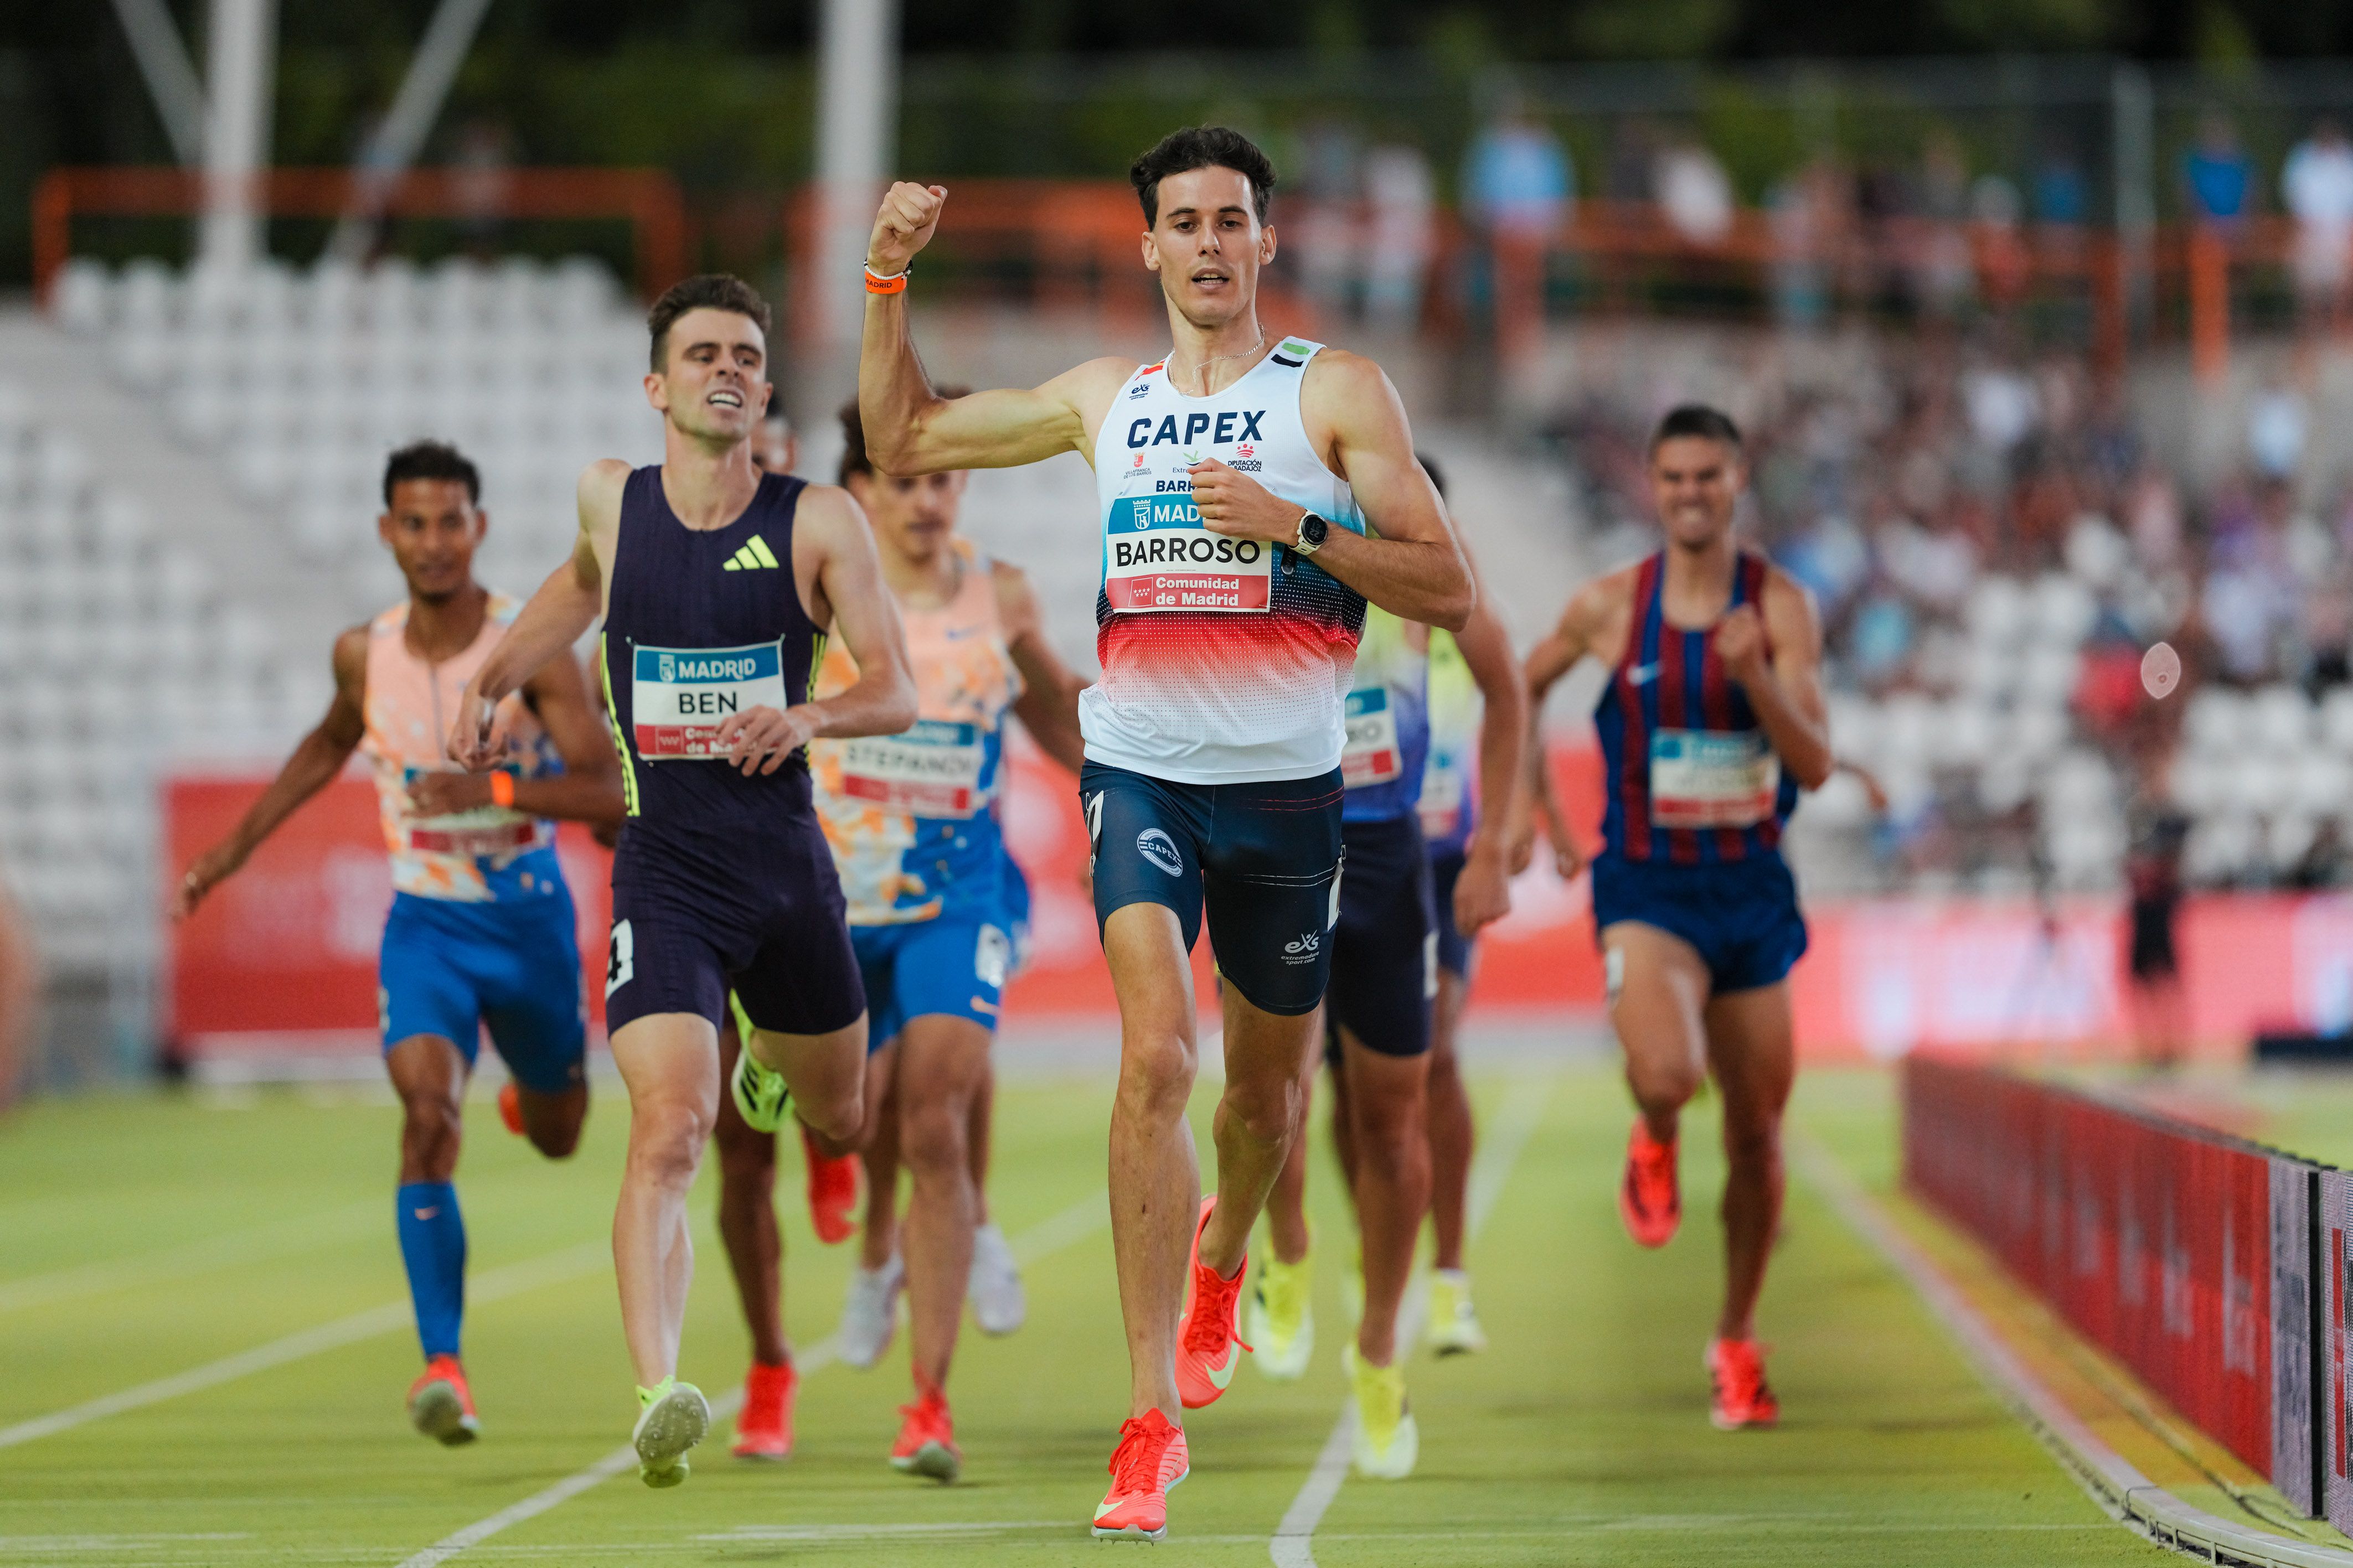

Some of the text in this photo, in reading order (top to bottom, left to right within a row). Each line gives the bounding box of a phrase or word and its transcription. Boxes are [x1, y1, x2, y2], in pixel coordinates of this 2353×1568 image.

[865, 278, 892, 288] MADRID
[1127, 410, 1266, 449] CAPEX
[1154, 504, 1201, 522] MAD
[1116, 537, 1261, 567] BARROSO
[1155, 577, 1239, 590] Comunidad
[1155, 592, 1239, 606] de Madrid
[678, 658, 756, 680] MADRID
[679, 692, 737, 714] BEN
[1148, 842, 1178, 864] CAPEX
[1281, 951, 1320, 961] extremadura
